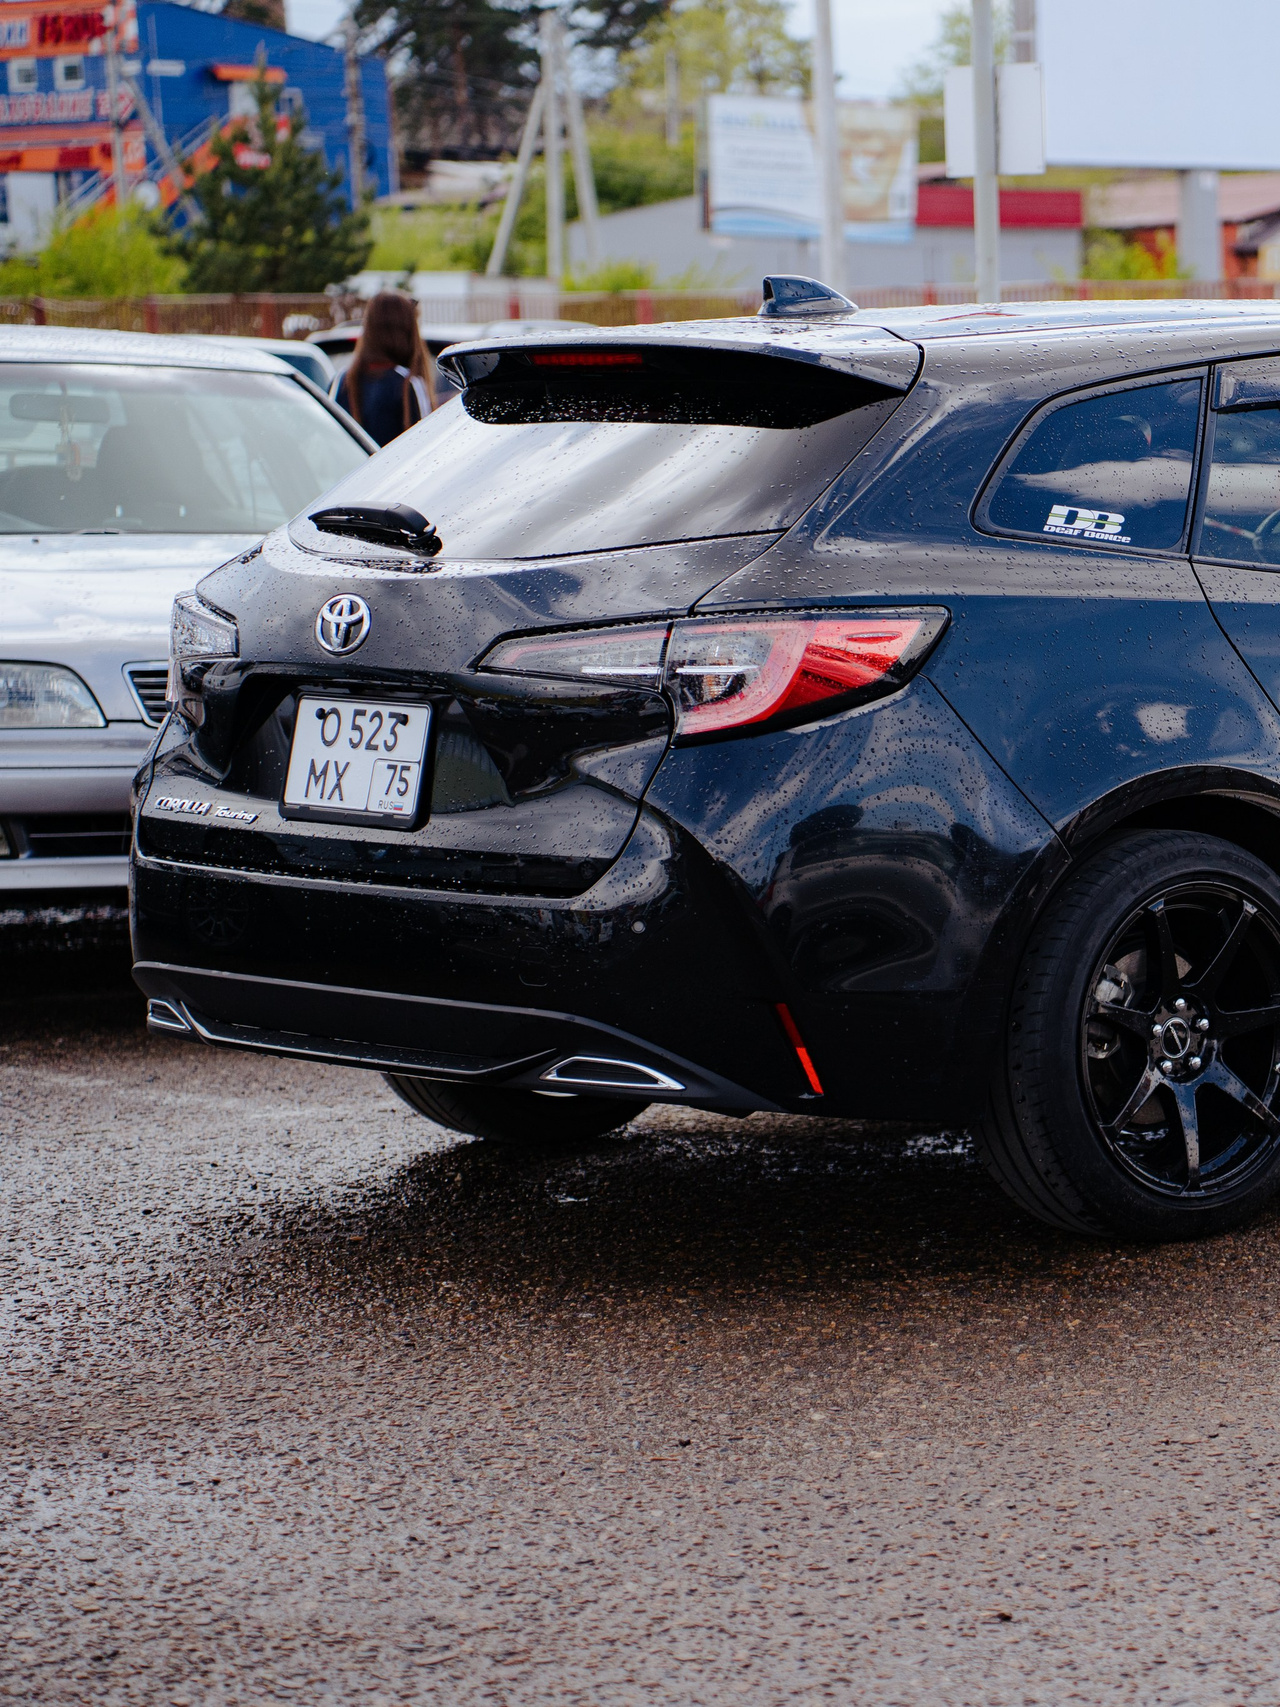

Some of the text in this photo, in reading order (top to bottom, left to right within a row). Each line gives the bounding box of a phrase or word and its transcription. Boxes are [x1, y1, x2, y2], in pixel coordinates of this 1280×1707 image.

[349, 709, 404, 752] 523
[385, 764, 411, 797] 75
[155, 797, 258, 824] COROLLA Touring
[377, 800, 394, 811] RUS
